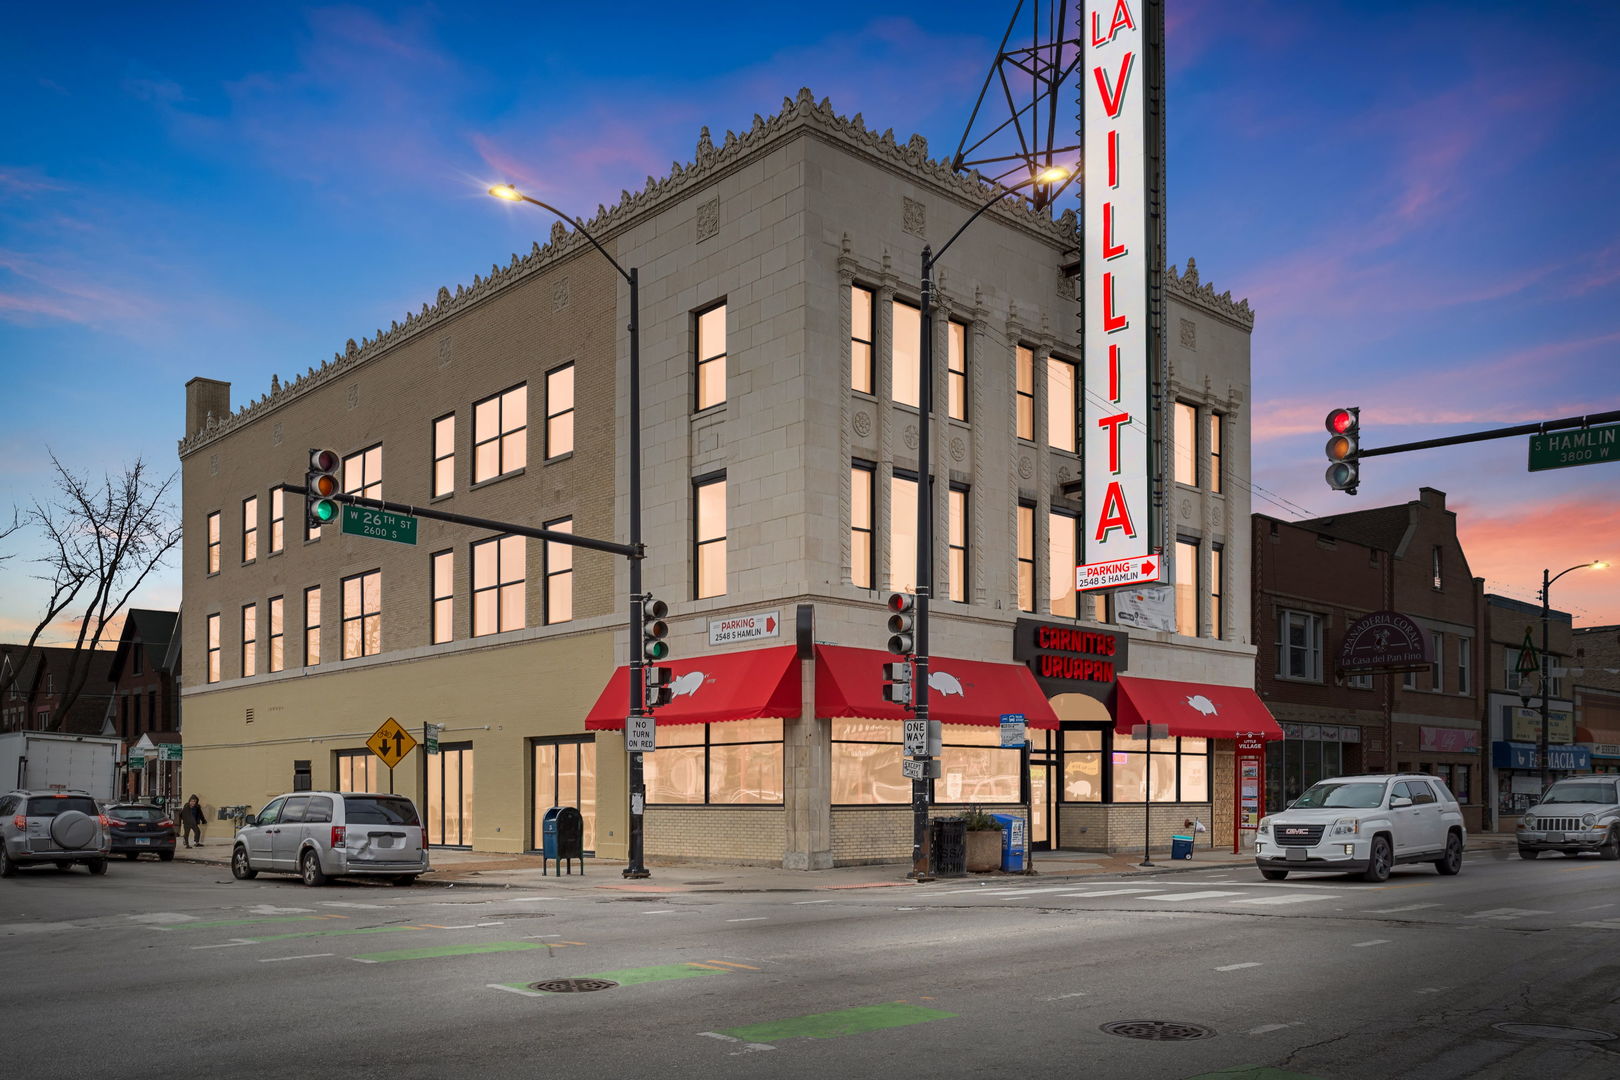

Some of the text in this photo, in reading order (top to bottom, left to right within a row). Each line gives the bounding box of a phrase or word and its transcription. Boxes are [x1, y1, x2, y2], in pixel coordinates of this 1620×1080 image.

[1092, 0, 1136, 48] LA
[1094, 51, 1137, 543] VILLITA
[1535, 429, 1616, 451] S HAMLIN
[1560, 447, 1609, 463] 3800 W
[350, 511, 412, 529] W 26TH ST
[364, 525, 397, 539] 2600 S
[1087, 562, 1130, 577] PARKING
[1079, 571, 1138, 587] 2548 S HAMLIN
[721, 618, 755, 632] PARKING
[1344, 615, 1419, 650] PANADERIA CORAL
[715, 628, 761, 641] 2548 S HAMLIN
[1038, 625, 1116, 656] CARNITAS
[1342, 652, 1421, 666] La Casa del Pan Fino
[1040, 654, 1114, 683] URUAPAN
[633, 730, 650, 738] TURN
[906, 722, 924, 732] ONE
[641, 740, 653, 748] RED
[906, 732, 925, 741] WAY
[1529, 750, 1575, 769] FMACIA
